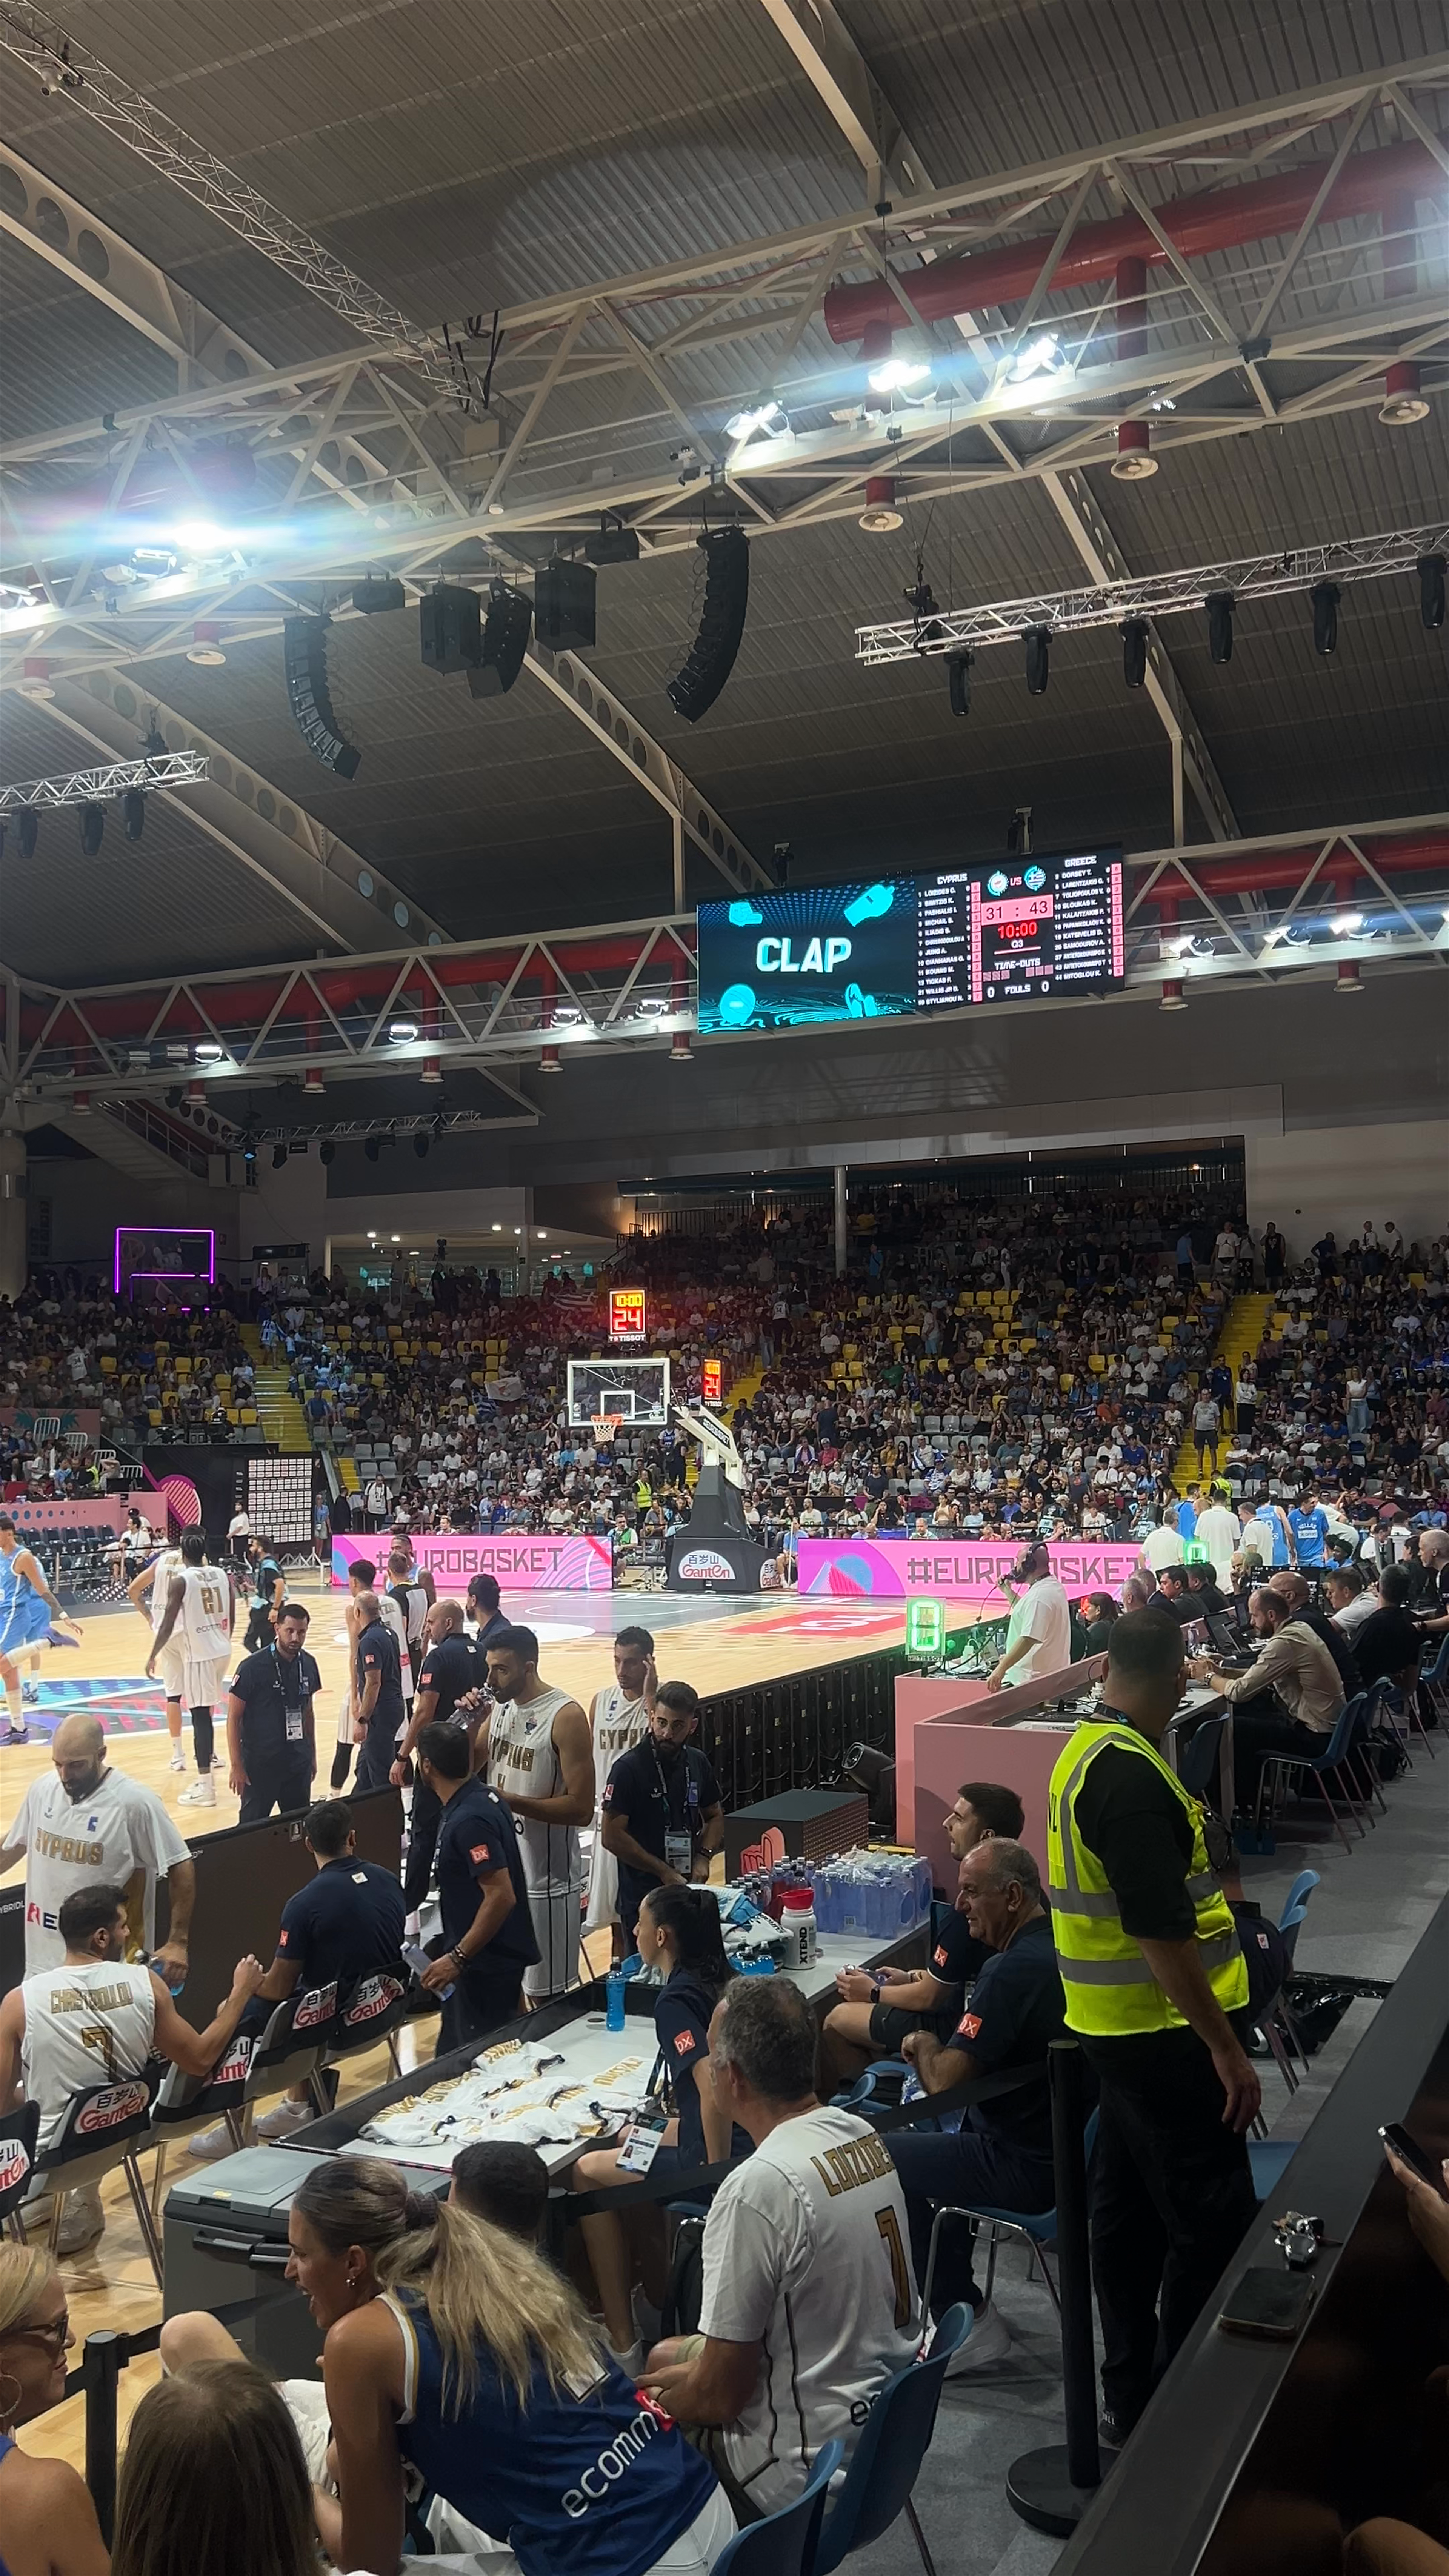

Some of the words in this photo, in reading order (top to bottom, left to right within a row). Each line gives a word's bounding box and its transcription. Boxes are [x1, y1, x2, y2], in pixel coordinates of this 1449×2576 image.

[1064, 855, 1097, 867] GREECE
[937, 873, 968, 884] CYPRUS
[1010, 877, 1022, 886] VS
[986, 906, 1001, 920] 31
[1030, 901, 1047, 914] 43
[998, 921, 1037, 938] 10:00
[1011, 939, 1023, 949] Q3
[756, 937, 852, 973] CLAP
[994, 958, 1040, 970] TIME-OUTS
[987, 986, 995, 998] 0
[1005, 984, 1031, 995] FOULS
[1041, 981, 1049, 992] 0
[614, 1310, 641, 1330] 24
[705, 1377, 719, 1396] 24
[376, 1548, 564, 1573] #UROBASKET
[764, 1564, 777, 1573] 百岁
[682, 1564, 730, 1578] Ganten
[201, 1587, 223, 1615] 21
[767, 1614, 900, 1632] TCL
[35, 1827, 104, 1866] CYPRUS
[799, 1927, 808, 1964] XTEND
[675, 2036, 692, 2052] bx
[82, 2026, 117, 2081] 7
[875, 2205, 910, 2330] 1
[561, 2410, 659, 2518] ecomm
